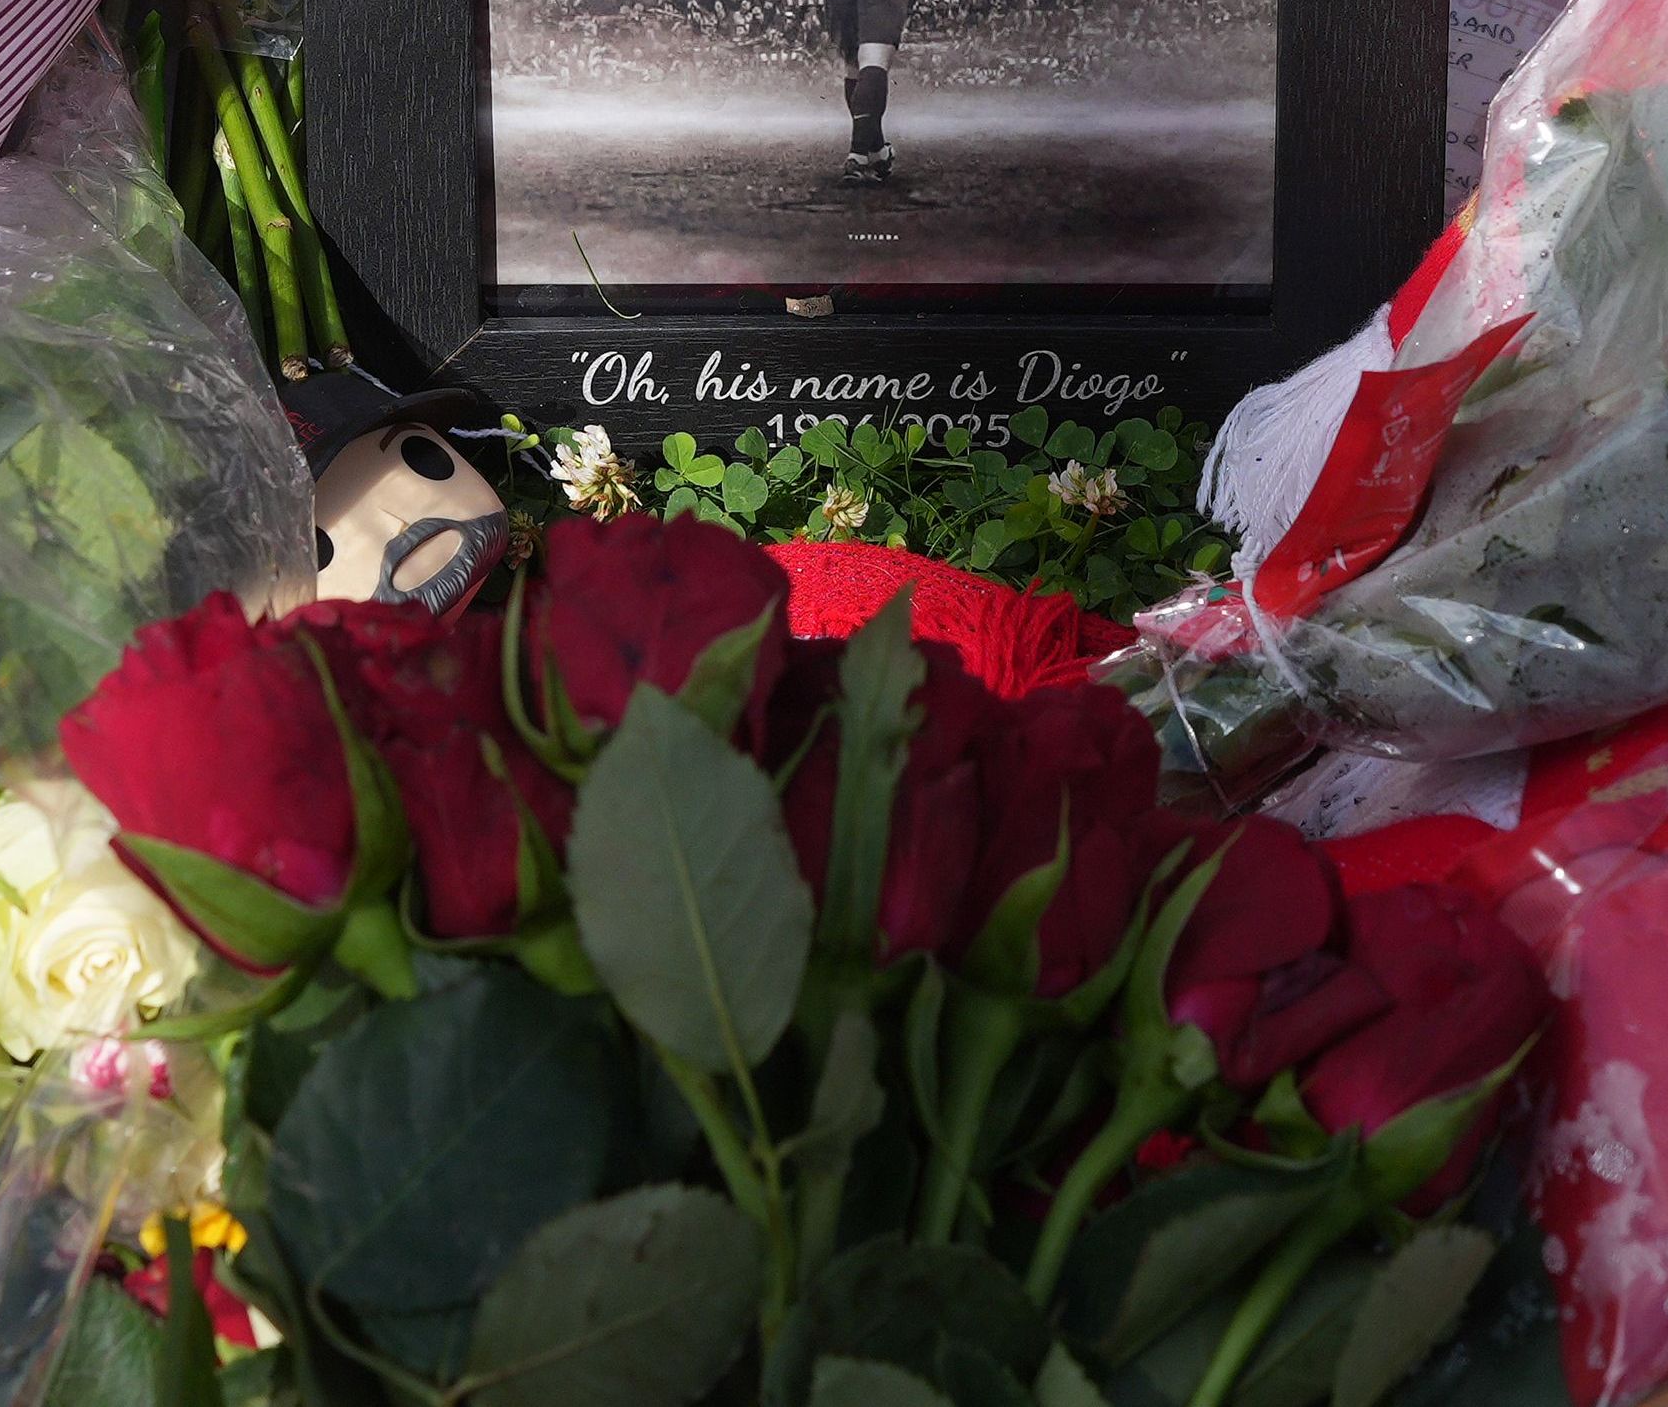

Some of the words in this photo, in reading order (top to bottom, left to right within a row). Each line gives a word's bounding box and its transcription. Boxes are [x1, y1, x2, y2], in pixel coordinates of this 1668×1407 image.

[695, 350, 778, 403] his
[790, 368, 935, 402] name
[950, 359, 998, 402] is
